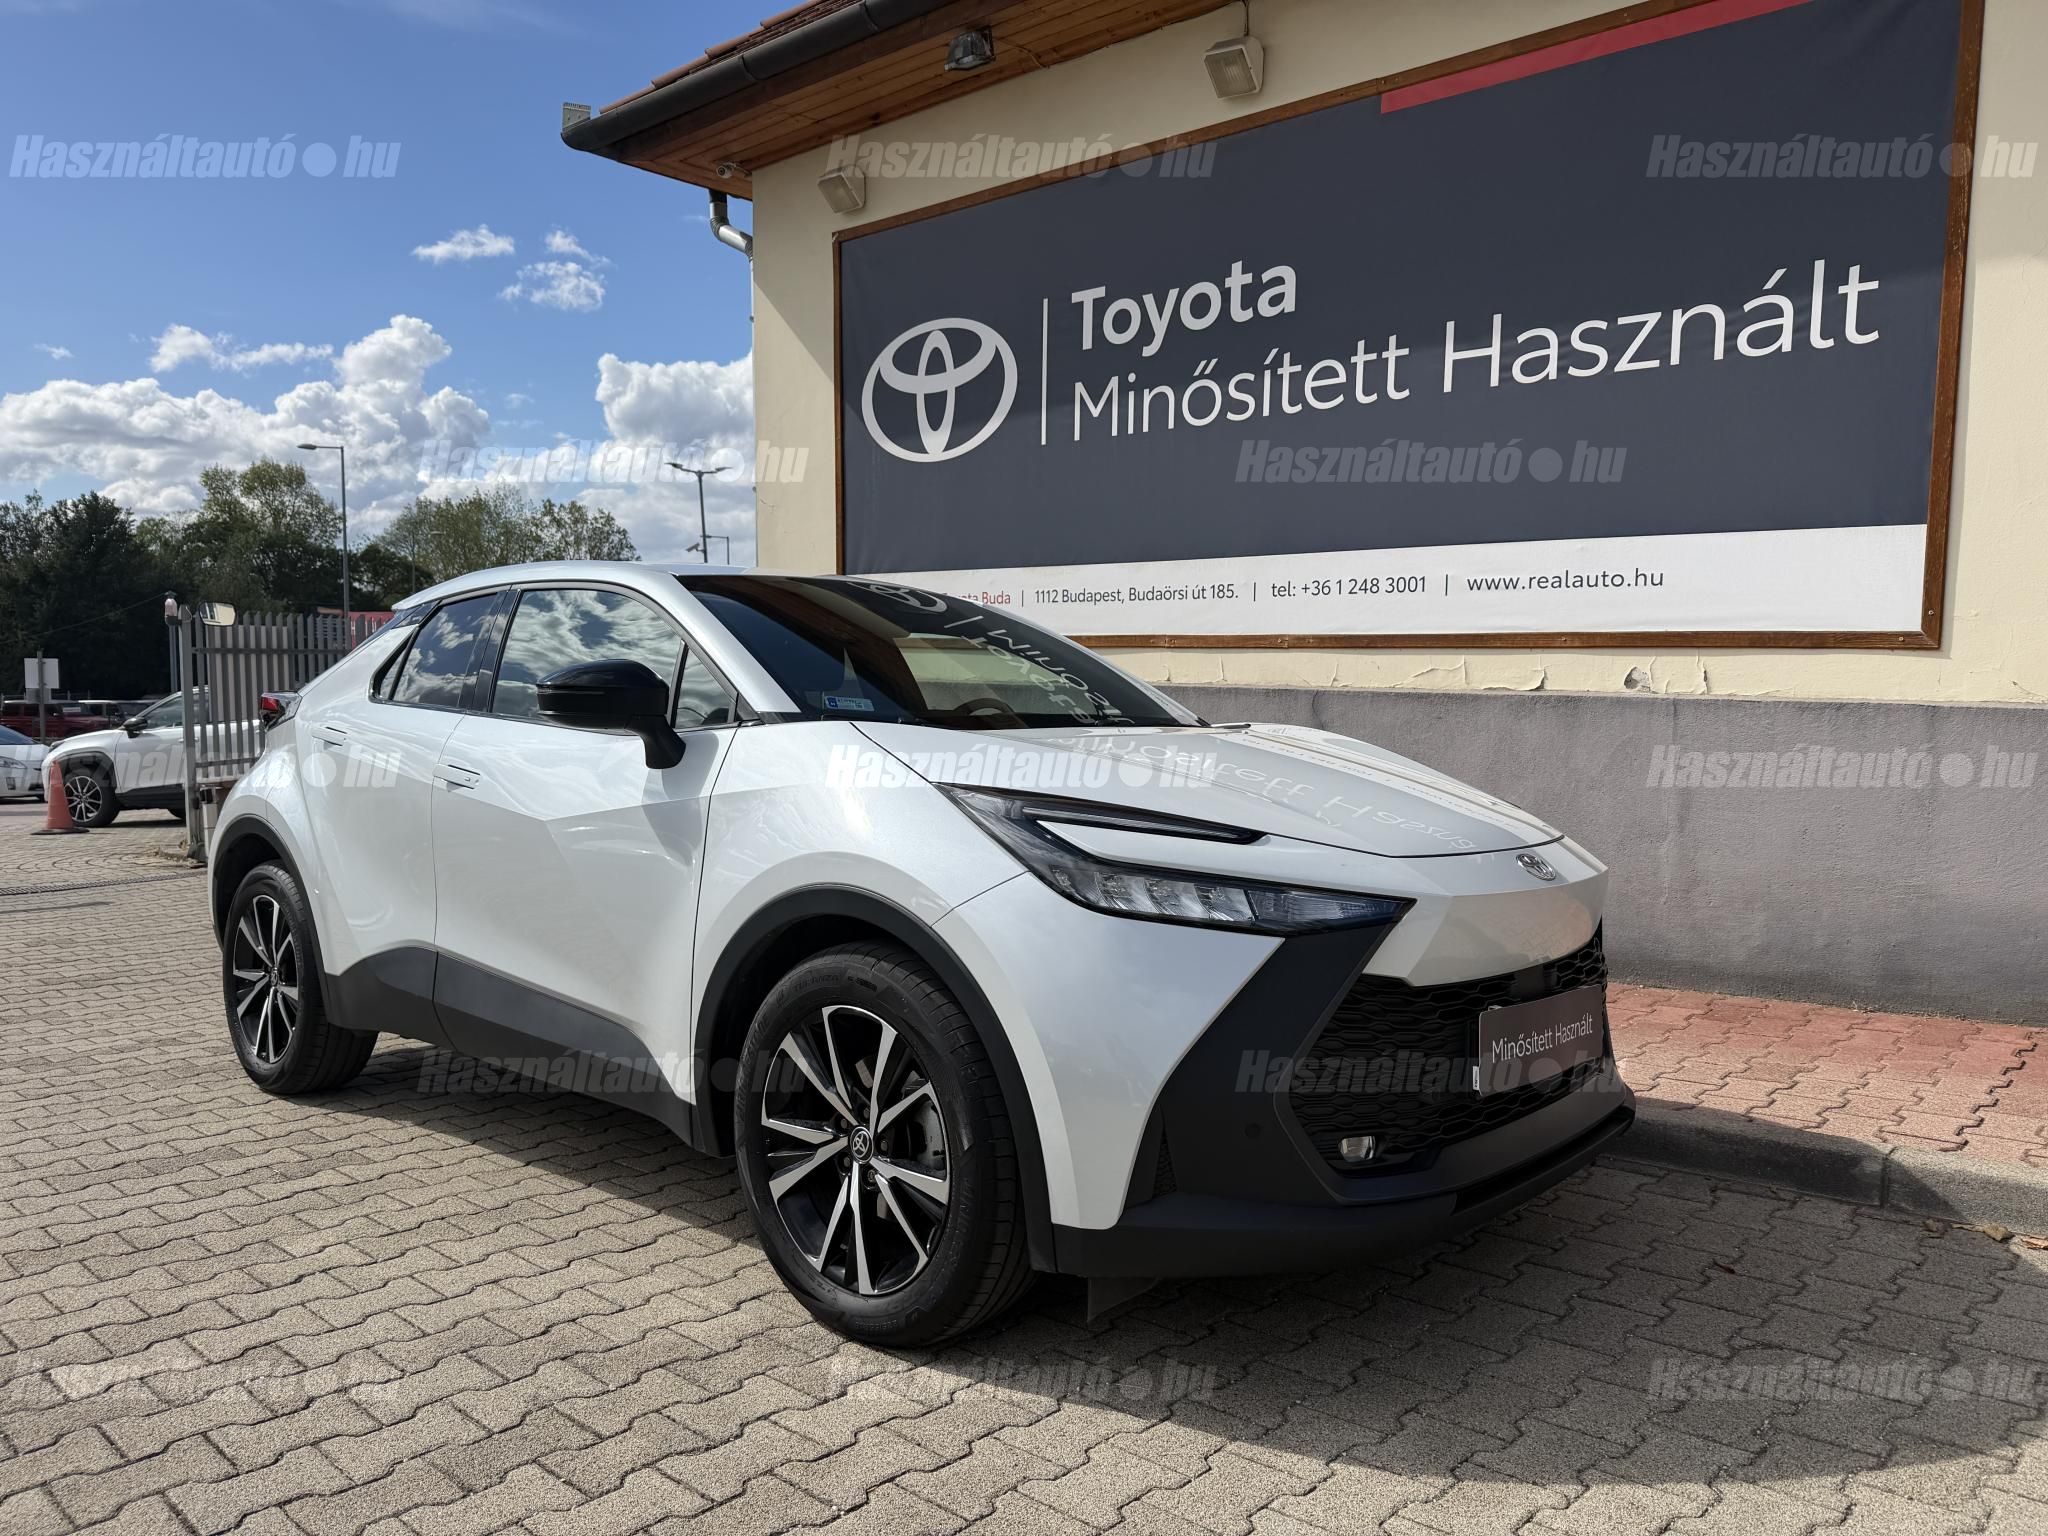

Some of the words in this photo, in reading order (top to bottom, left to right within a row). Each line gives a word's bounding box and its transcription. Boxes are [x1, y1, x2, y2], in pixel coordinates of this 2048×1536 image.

[1071, 260, 1297, 357] Toyota
[1074, 334, 1411, 442] Minősített
[1443, 258, 1880, 393] Használt
[981, 590, 1011, 605] Buda
[1034, 588, 1059, 604] 1112
[1061, 587, 1125, 606] Budapest,
[1128, 584, 1188, 602] Budaörsi
[1191, 583, 1207, 600] út
[1210, 583, 1239, 600] 185.
[1271, 580, 1296, 598] tel:
[1301, 579, 1331, 596] +36
[1336, 579, 1343, 595] 1
[1348, 577, 1380, 595] 248
[1384, 575, 1426, 594] 3001
[1466, 567, 1664, 592] www.realauto.hu
[1491, 1028, 1553, 1064] Minősített
[1555, 1012, 1593, 1047] Használt
